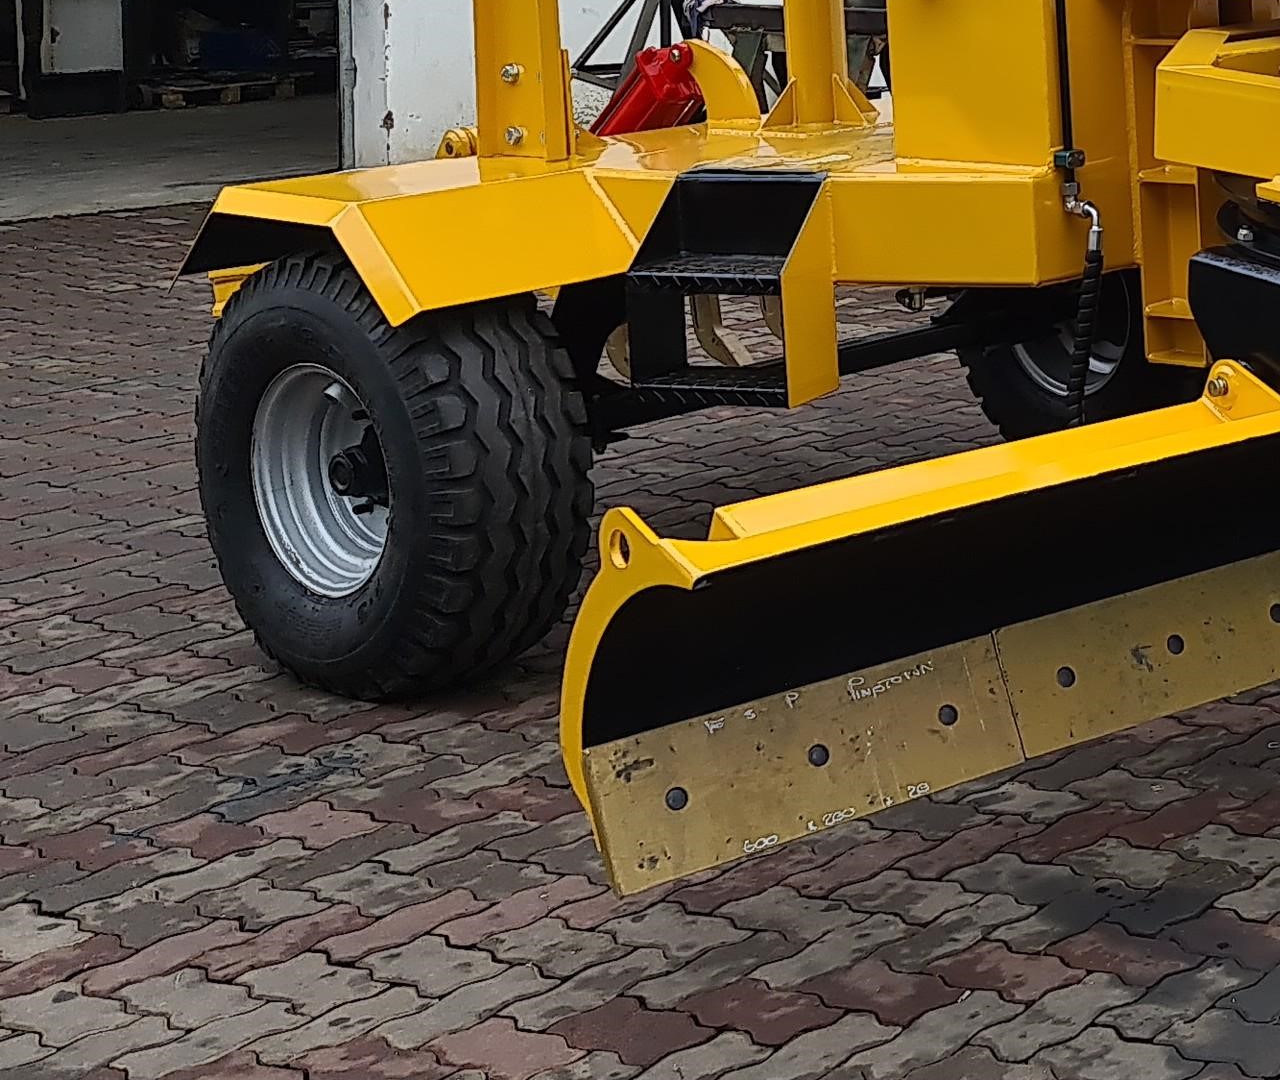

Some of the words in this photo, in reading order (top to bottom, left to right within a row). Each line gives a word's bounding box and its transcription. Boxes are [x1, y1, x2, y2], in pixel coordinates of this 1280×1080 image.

[785, 691, 800, 709] P
[743, 834, 779, 853] 600
[907, 781, 931, 799] 20
